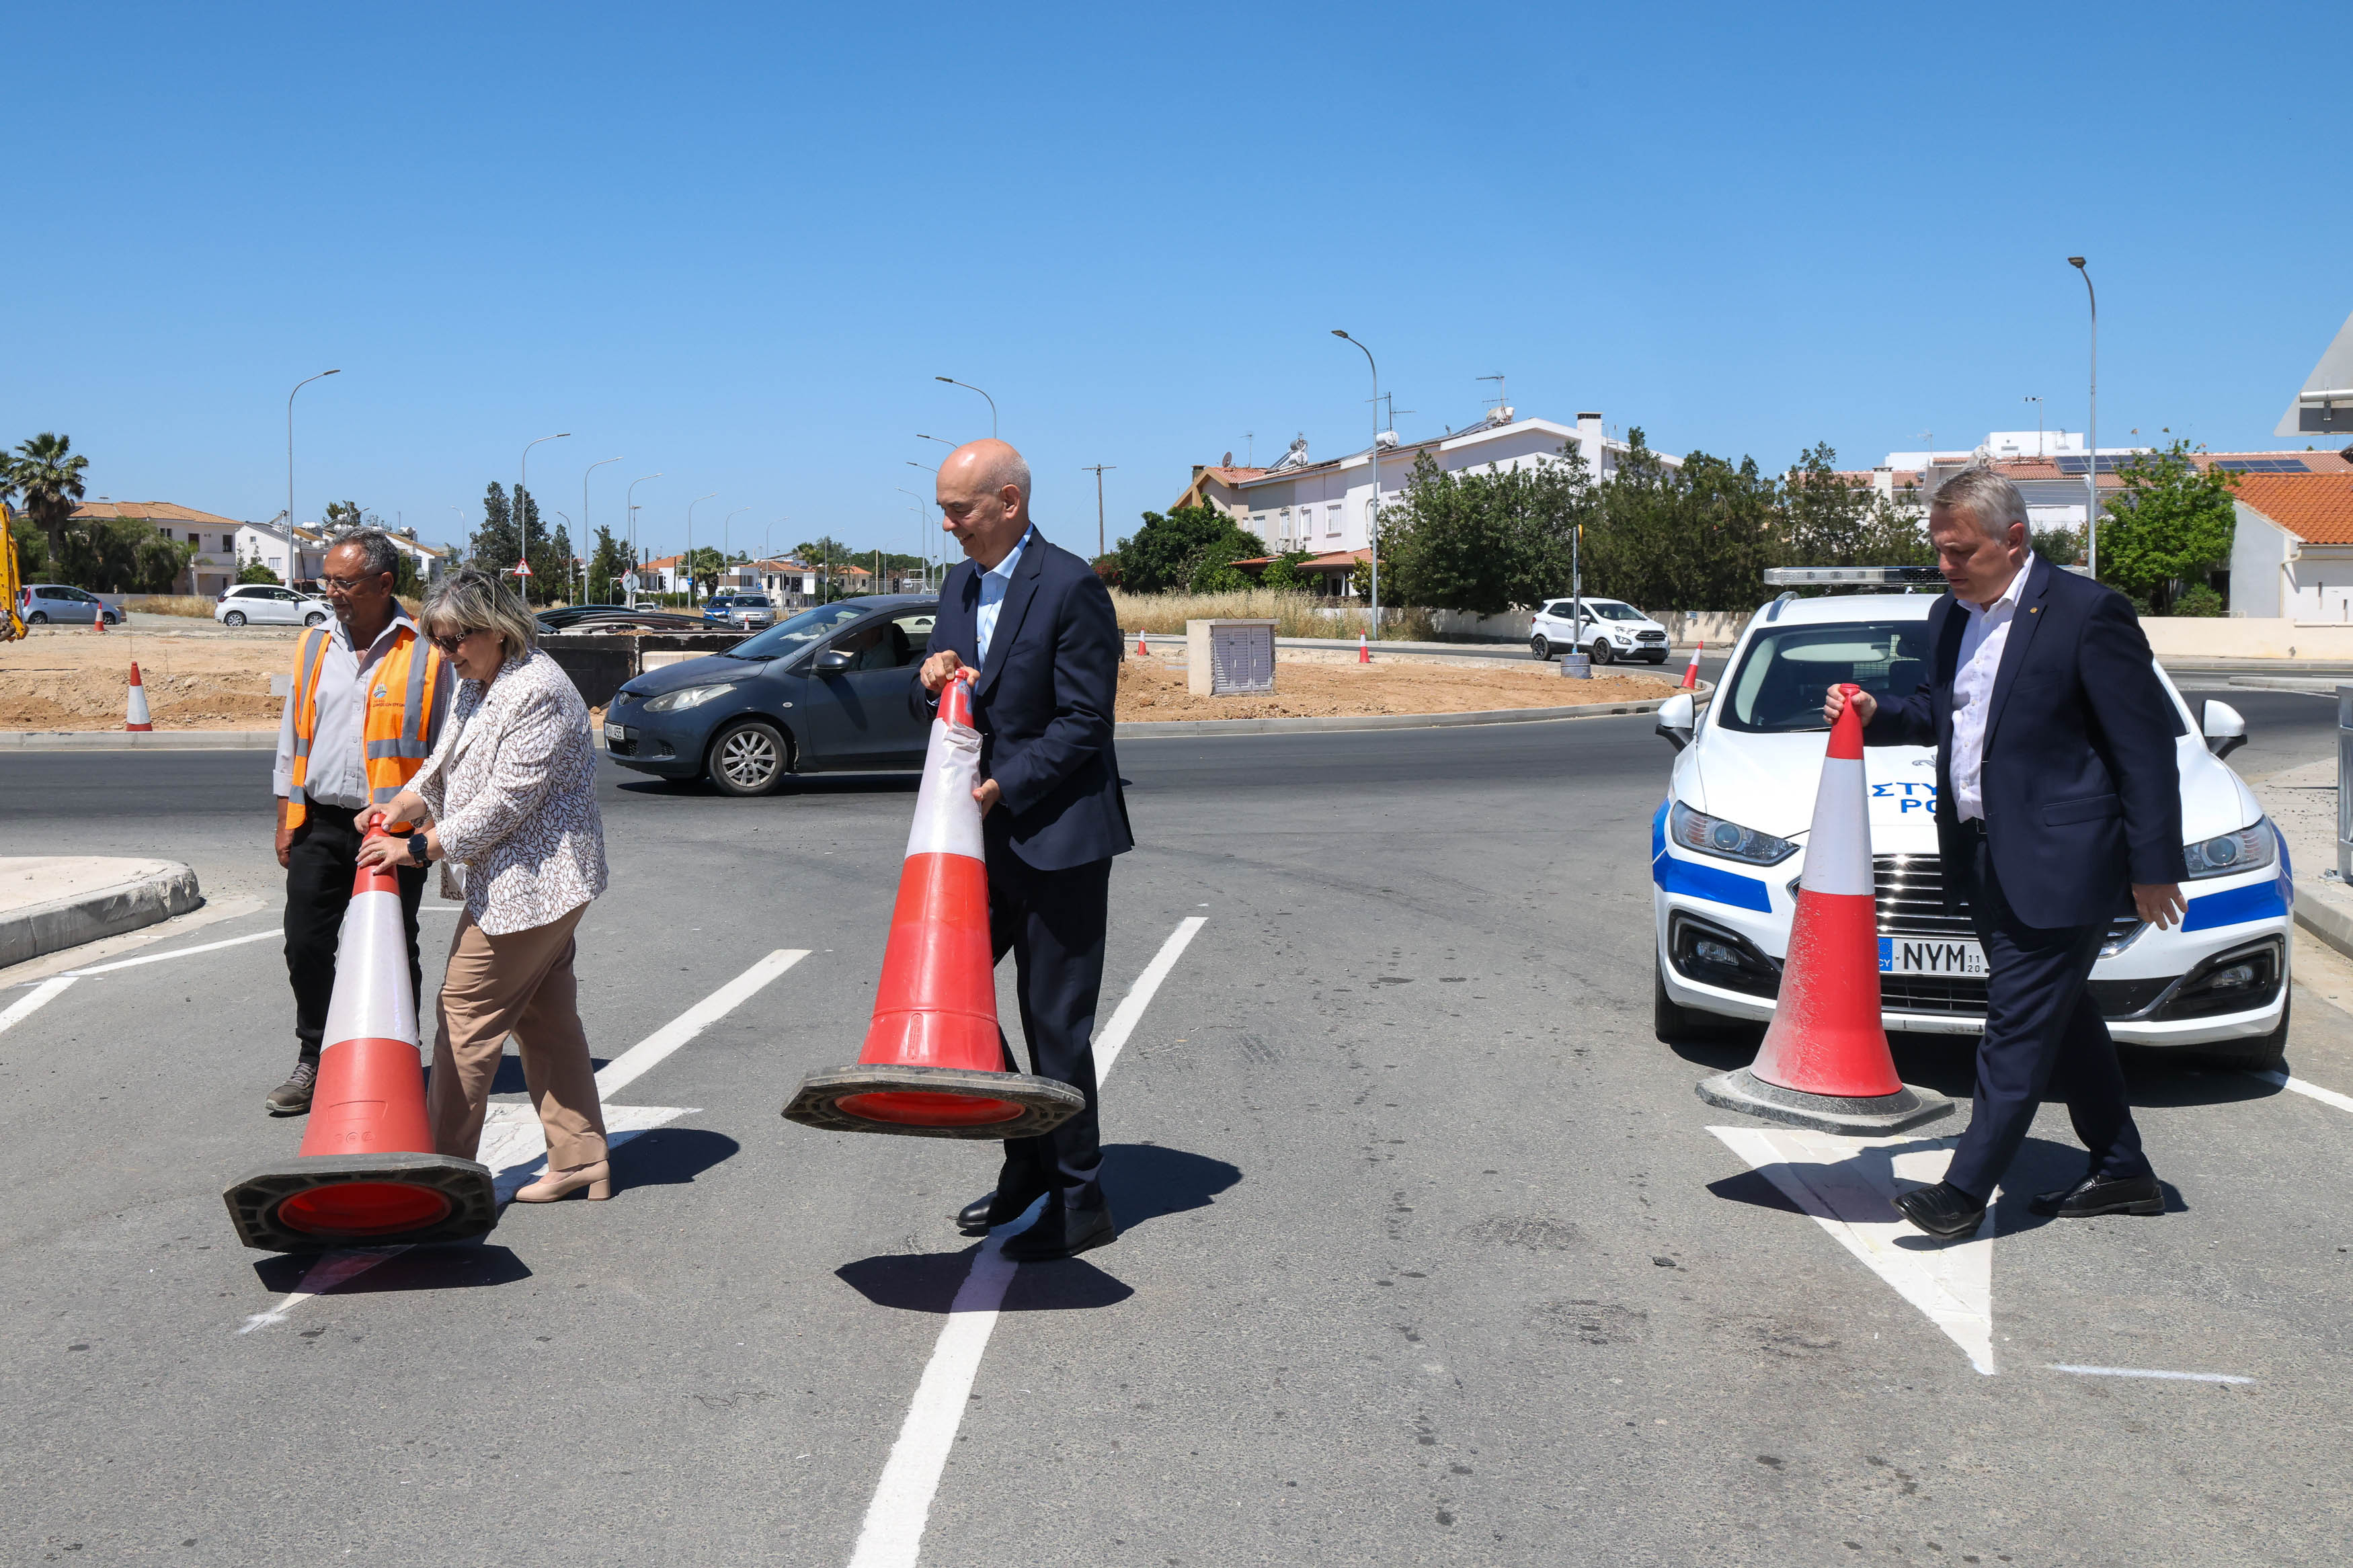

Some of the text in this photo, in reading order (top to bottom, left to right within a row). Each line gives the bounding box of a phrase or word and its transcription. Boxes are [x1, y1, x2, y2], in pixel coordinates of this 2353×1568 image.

[1868, 782, 1937, 797] ΣΤΥ
[1904, 942, 1965, 973] NYM
[1968, 954, 1980, 964] 11
[1968, 964, 1981, 973] 20
